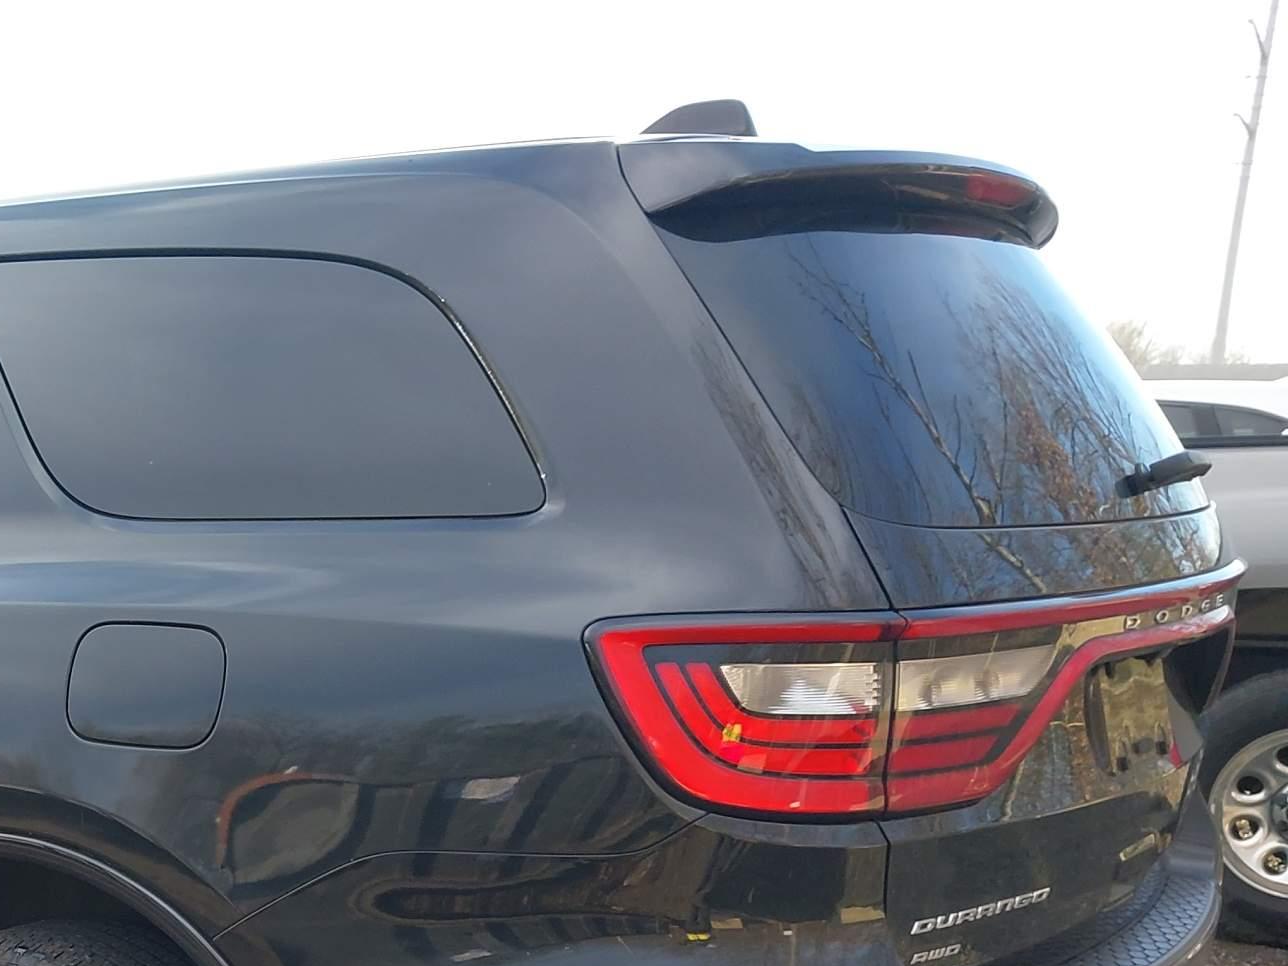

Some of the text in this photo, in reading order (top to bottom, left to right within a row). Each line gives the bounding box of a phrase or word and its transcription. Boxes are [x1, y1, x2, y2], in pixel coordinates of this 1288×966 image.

[1125, 593, 1225, 630] DODGE
[910, 887, 1052, 936] DURANGO
[910, 943, 962, 966] AWD
